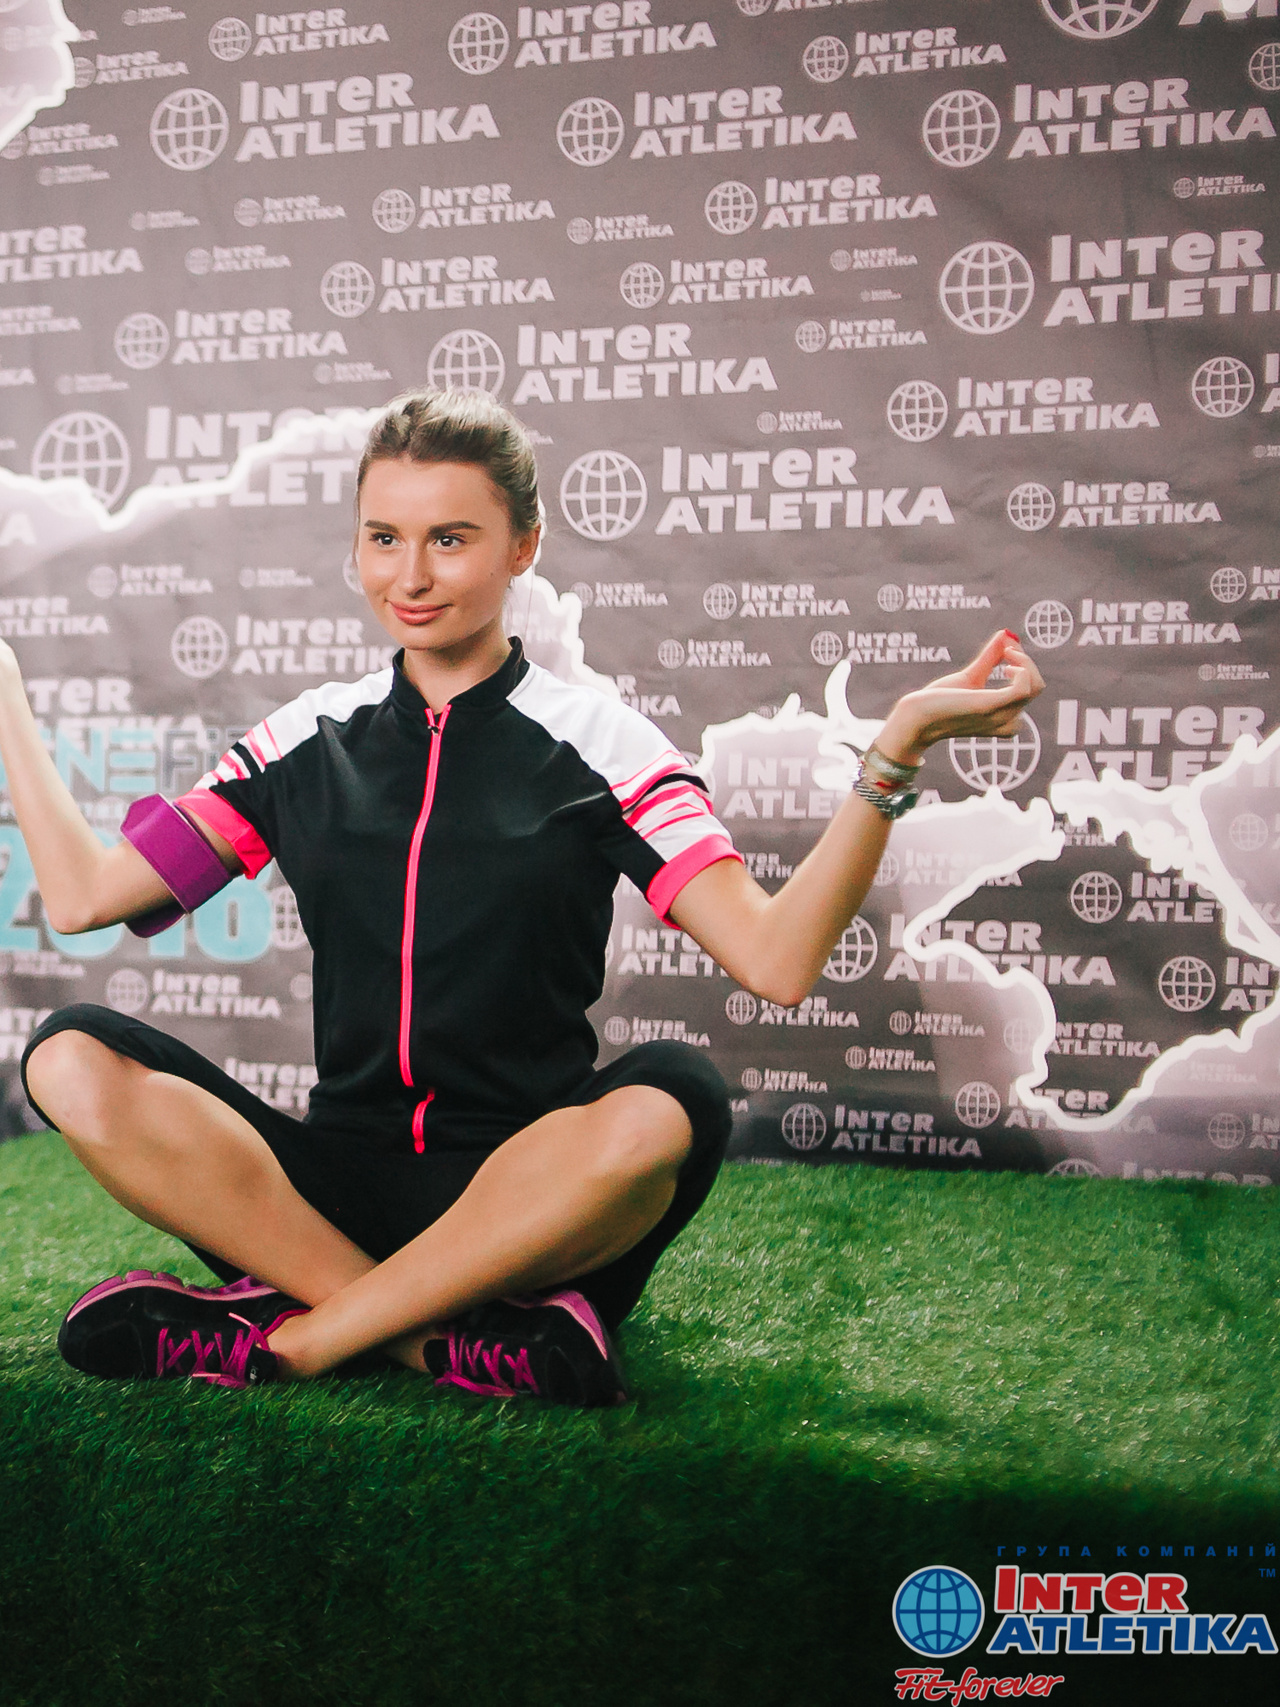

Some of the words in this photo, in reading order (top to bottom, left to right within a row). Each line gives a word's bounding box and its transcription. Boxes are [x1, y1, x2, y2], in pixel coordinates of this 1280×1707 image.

[253, 23, 390, 56] ATLETIKA
[514, 21, 718, 68] ATLETIKA
[852, 44, 1007, 78] ATLETIKA
[234, 103, 500, 162] ATLETIKA
[629, 111, 858, 160] ATLETIKA
[1008, 107, 1277, 160] ATLETIKA
[418, 200, 556, 229] ATLETIKA
[761, 194, 938, 230] ATLETIKA
[378, 277, 556, 313] ATLETIKA
[668, 275, 815, 305] ATLETIKA
[1043, 273, 1280, 327] ATLETI
[172, 331, 348, 365] ATLETIKA
[827, 330, 928, 350] ATLETIKA
[512, 357, 778, 405] ATLETIKA
[952, 402, 1161, 438] ATLETIKA
[655, 486, 956, 535] ATLETIKA
[1058, 502, 1222, 528] ATLETIKA
[739, 599, 851, 618] ATLETIKA
[905, 595, 991, 610] ATLETIKA
[1078, 622, 1242, 646] ATLETIKA
[232, 646, 393, 677] ATLETIK
[847, 646, 952, 665] ATLETIKA
[150, 995, 281, 1019] ATLETIKA
[758, 1008, 860, 1028] ATLETIKA
[831, 1131, 982, 1159] ATLETIKA
